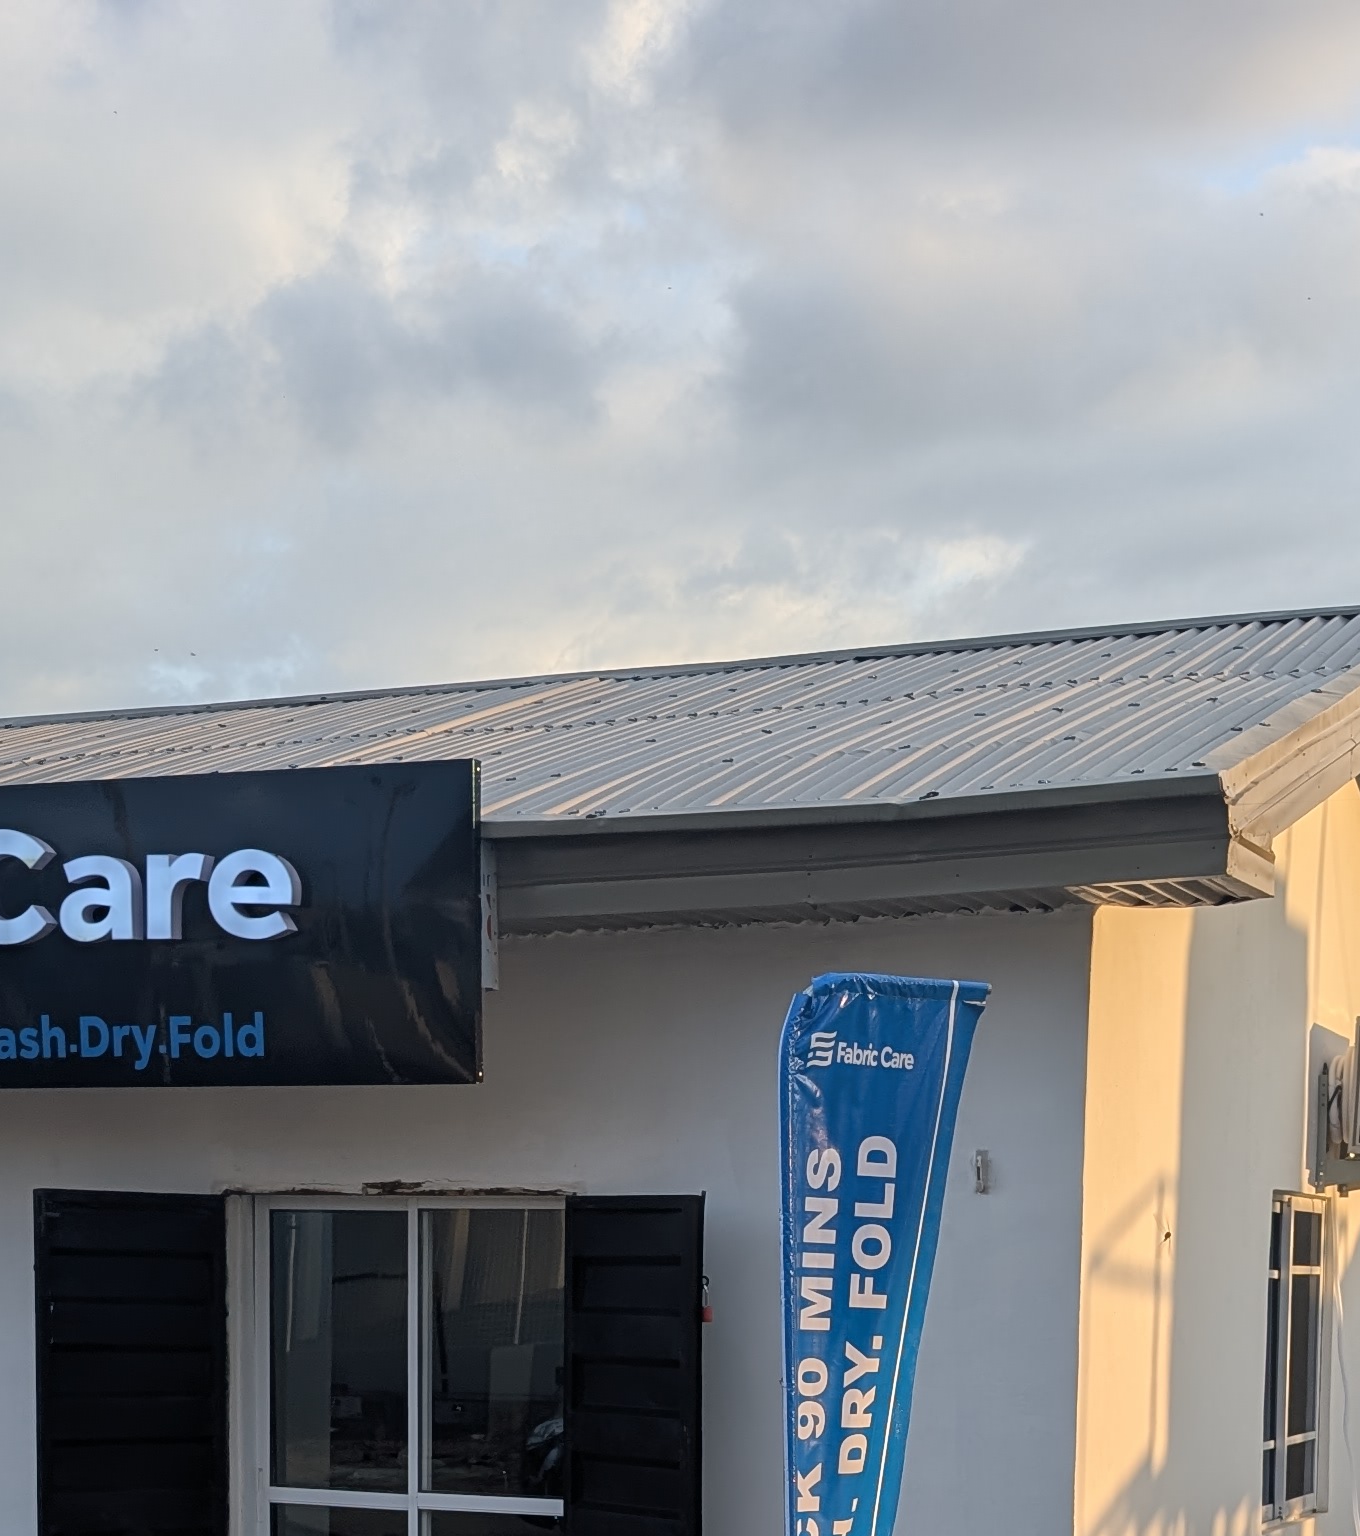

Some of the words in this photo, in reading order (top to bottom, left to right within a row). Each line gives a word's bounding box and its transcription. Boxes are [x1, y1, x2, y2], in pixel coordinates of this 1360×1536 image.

[836, 1042, 879, 1067] Fabric
[881, 1046, 915, 1070] Care
[799, 1148, 841, 1331] MINS
[848, 1135, 898, 1309] FOLD
[797, 1357, 829, 1440] 90
[838, 1335, 884, 1475] DRY.
